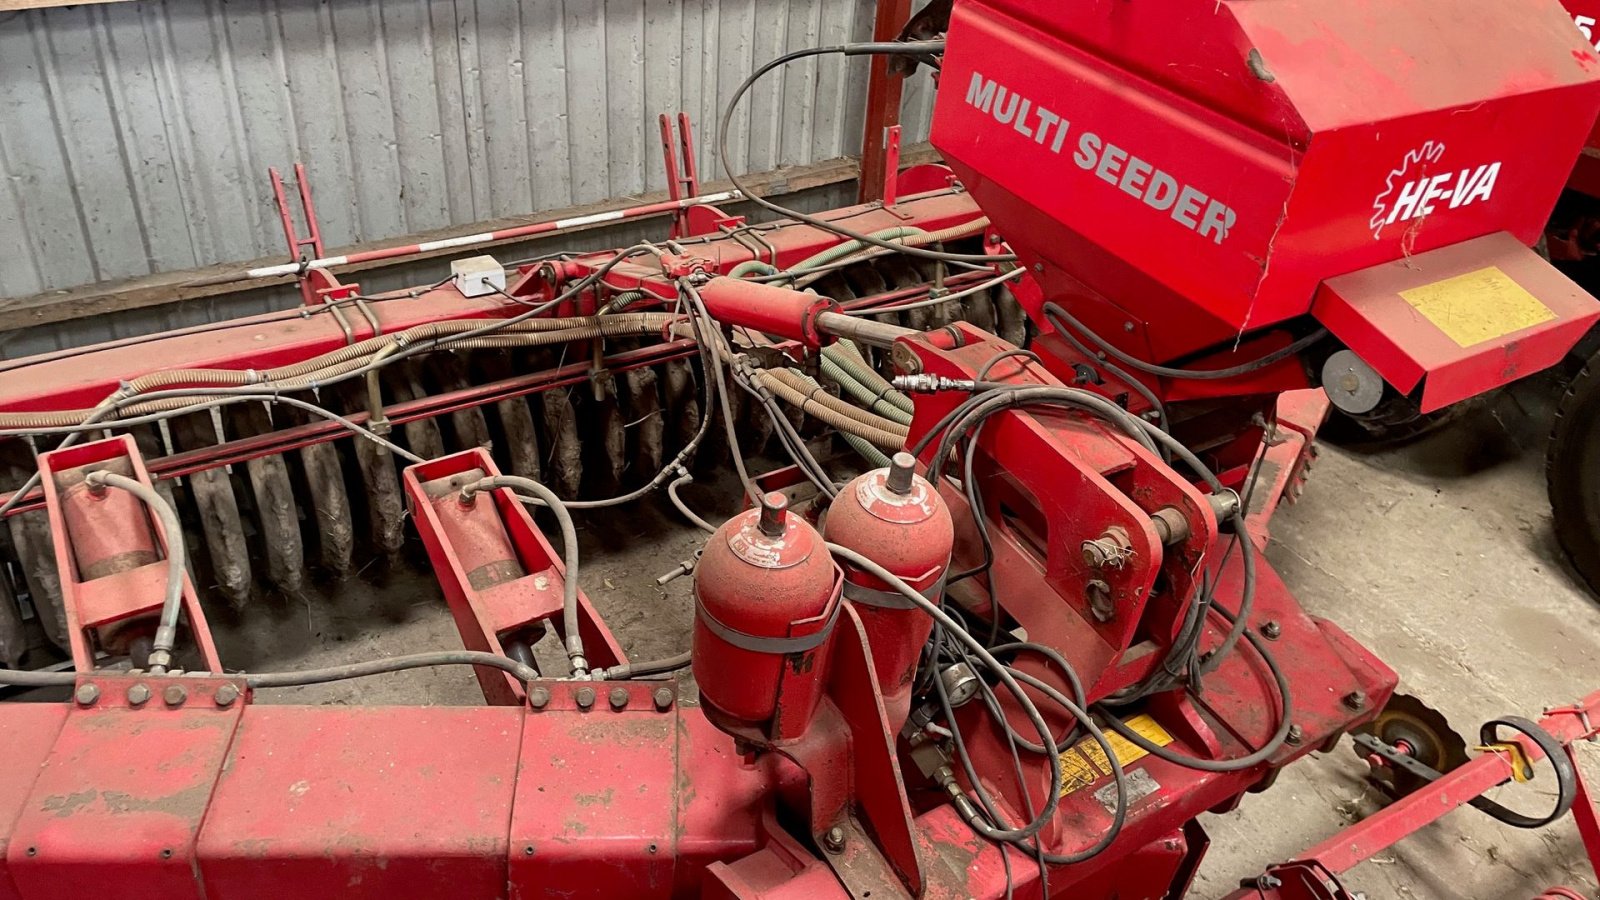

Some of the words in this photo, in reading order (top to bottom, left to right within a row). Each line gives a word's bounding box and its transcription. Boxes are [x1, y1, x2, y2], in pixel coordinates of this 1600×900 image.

[965, 71, 1070, 154] MULTI
[1073, 132, 1236, 245] SEEDER
[1385, 162, 1501, 225] HE-VA
